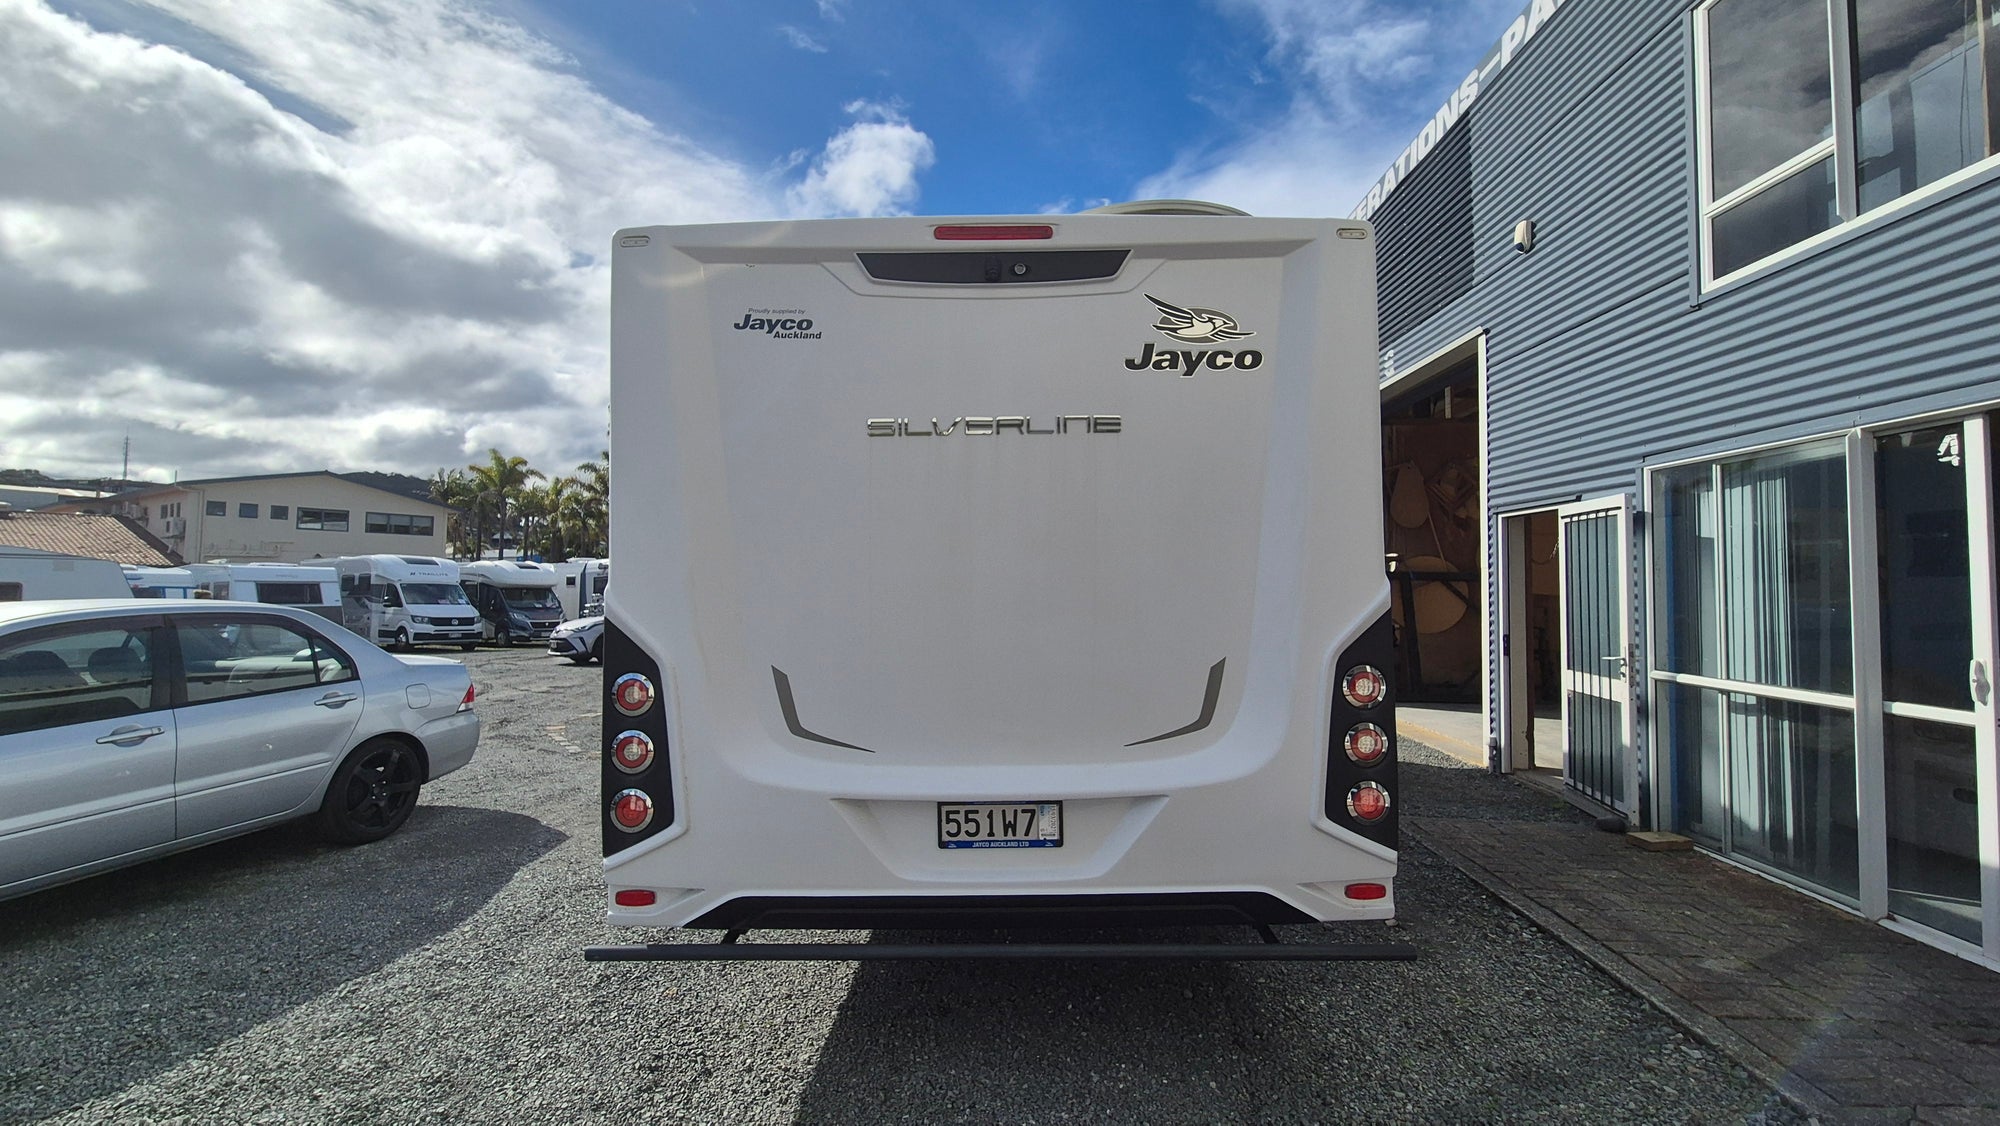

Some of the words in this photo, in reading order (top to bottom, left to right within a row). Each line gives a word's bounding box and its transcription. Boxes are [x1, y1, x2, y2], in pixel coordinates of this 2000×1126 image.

[733, 314, 813, 334] Jayco
[773, 331, 822, 339] Auckland
[1124, 342, 1264, 378] Jayco
[867, 415, 1121, 437] SILVERLINE
[945, 808, 1036, 838] 551W7
